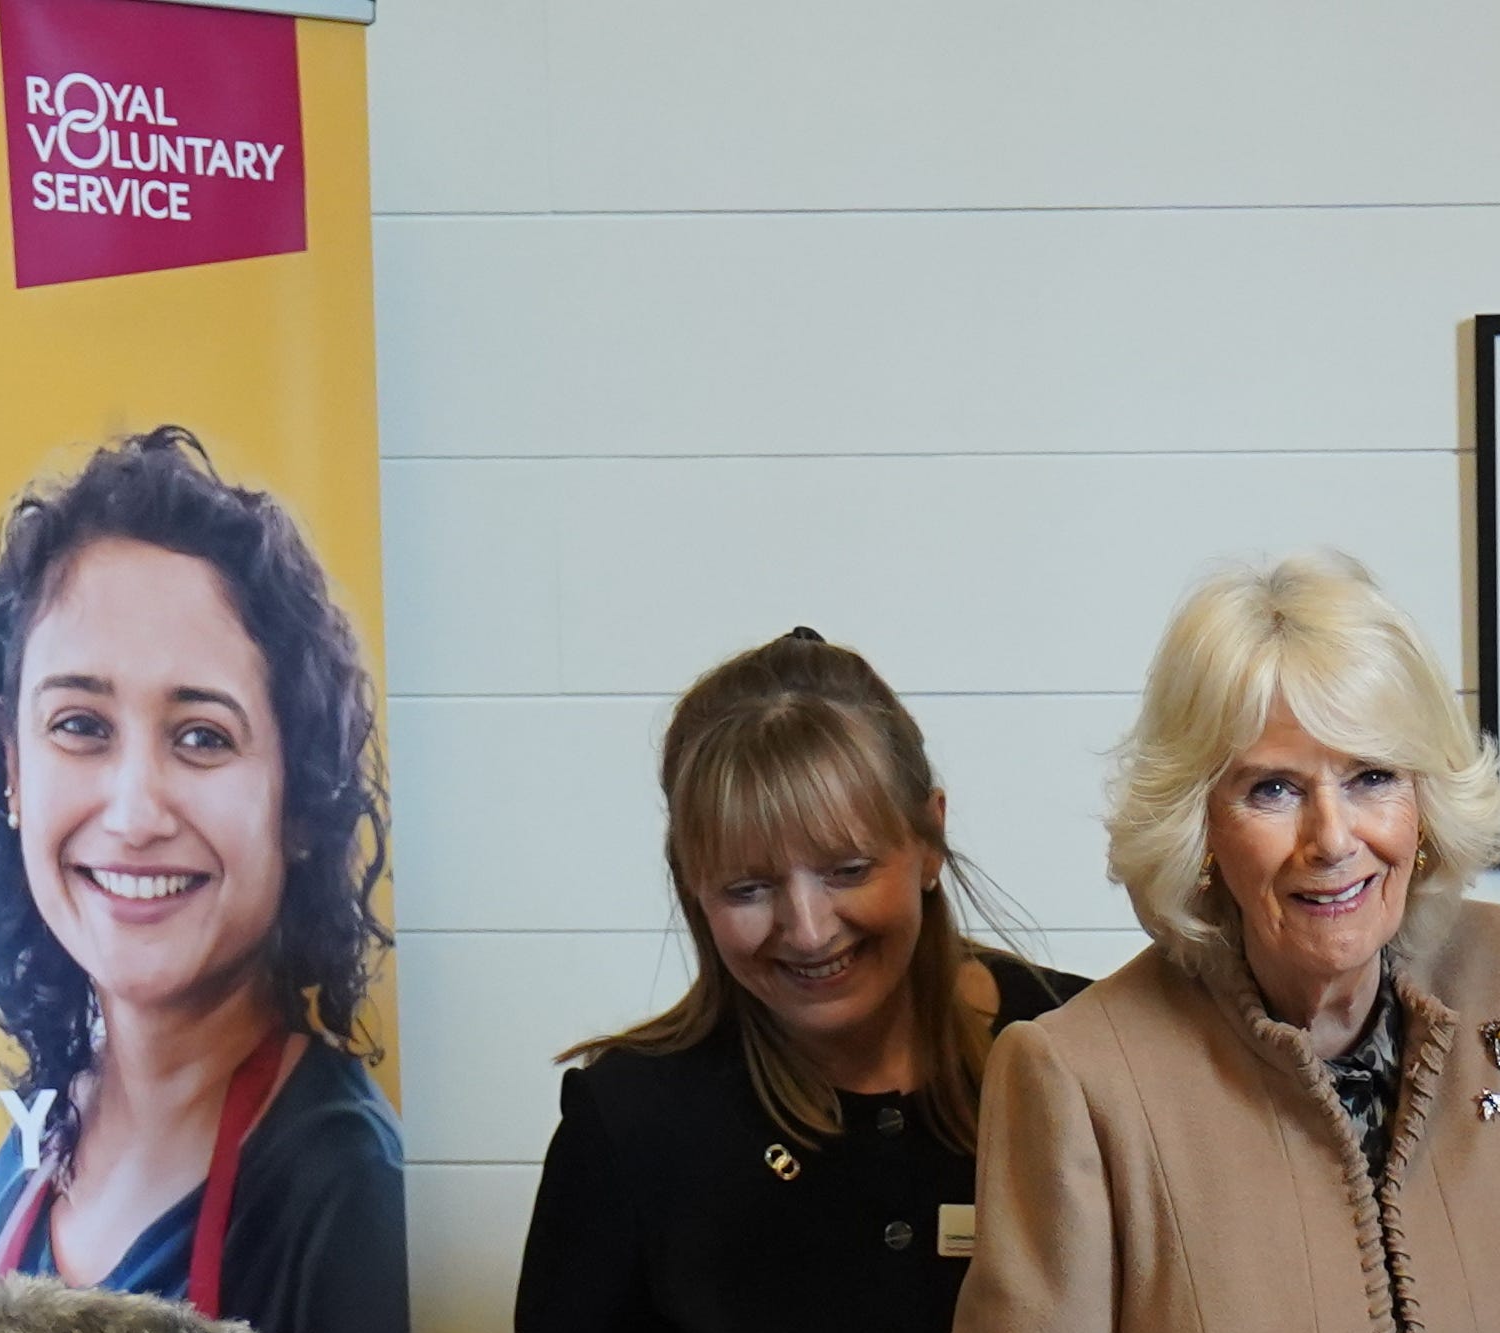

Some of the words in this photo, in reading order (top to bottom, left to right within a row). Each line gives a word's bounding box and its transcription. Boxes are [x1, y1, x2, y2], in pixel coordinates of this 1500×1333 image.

[26, 72, 177, 133] ROYAL
[26, 111, 284, 182] VOLUNTARY
[32, 172, 192, 221] SERVICE
